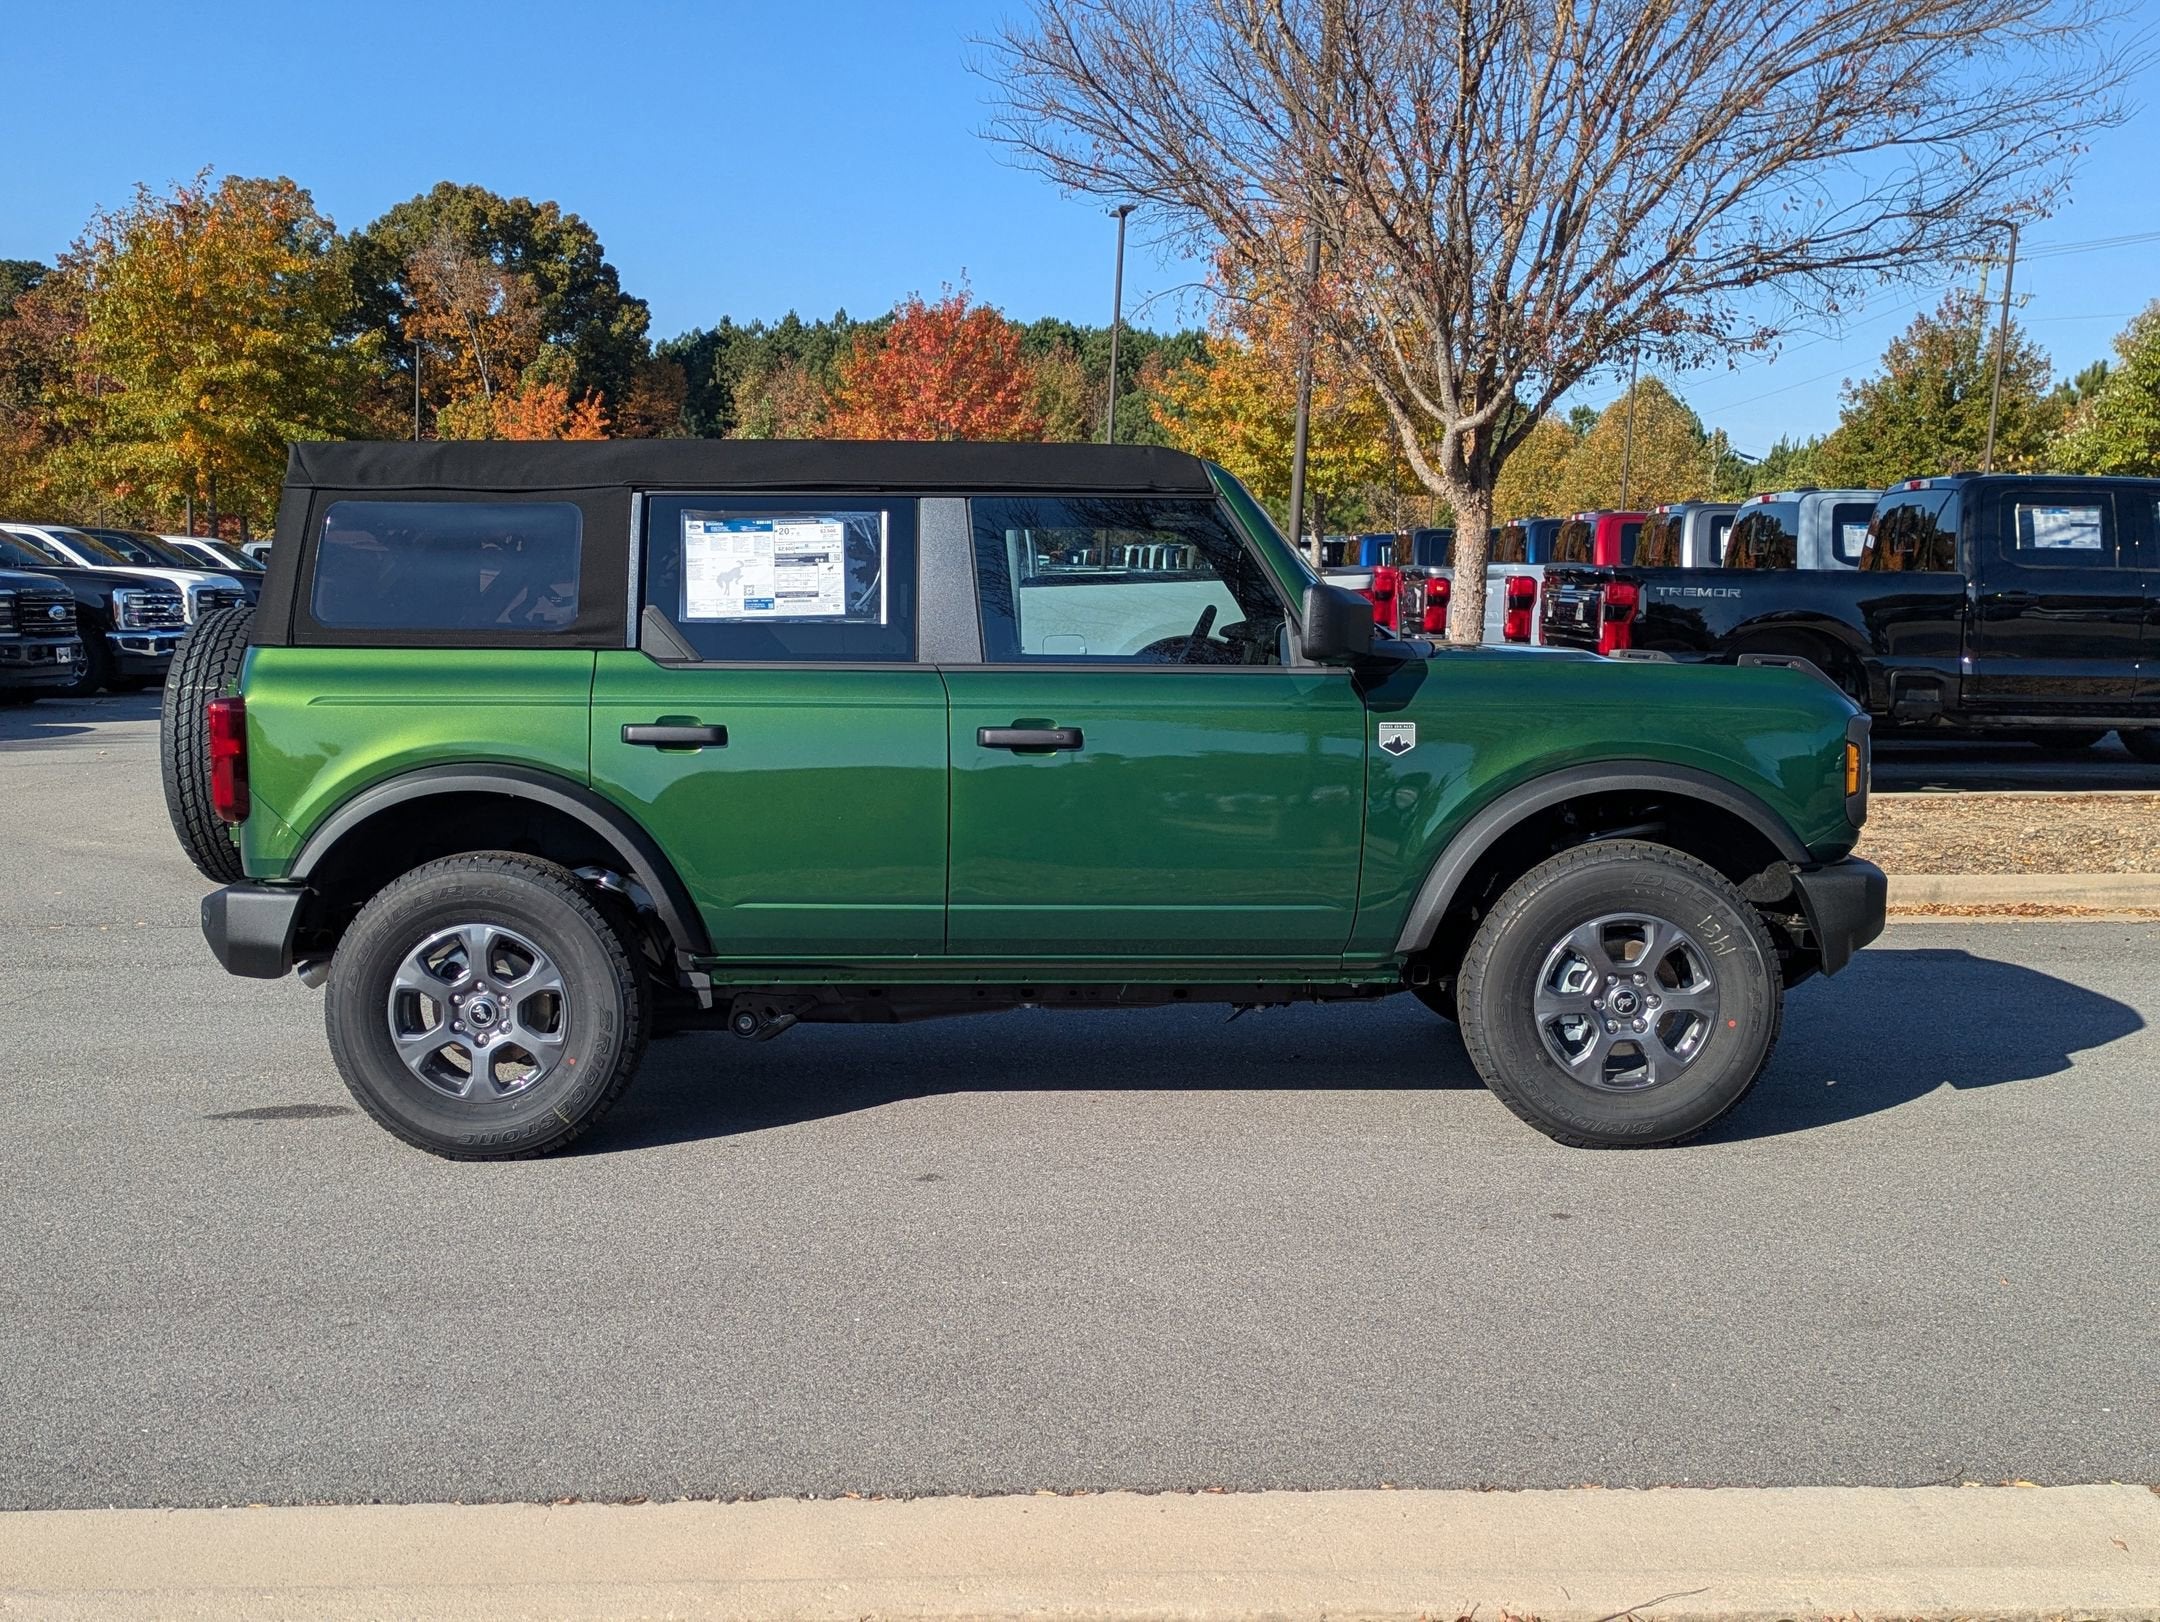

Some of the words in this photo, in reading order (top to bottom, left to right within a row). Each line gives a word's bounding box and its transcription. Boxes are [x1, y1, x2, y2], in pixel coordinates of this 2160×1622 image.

[778, 527, 790, 535] 20
[1656, 586, 1742, 598] TREMOR
[345, 887, 466, 997] DUELER
[460, 1008, 614, 1147] BRIDGESTONE
